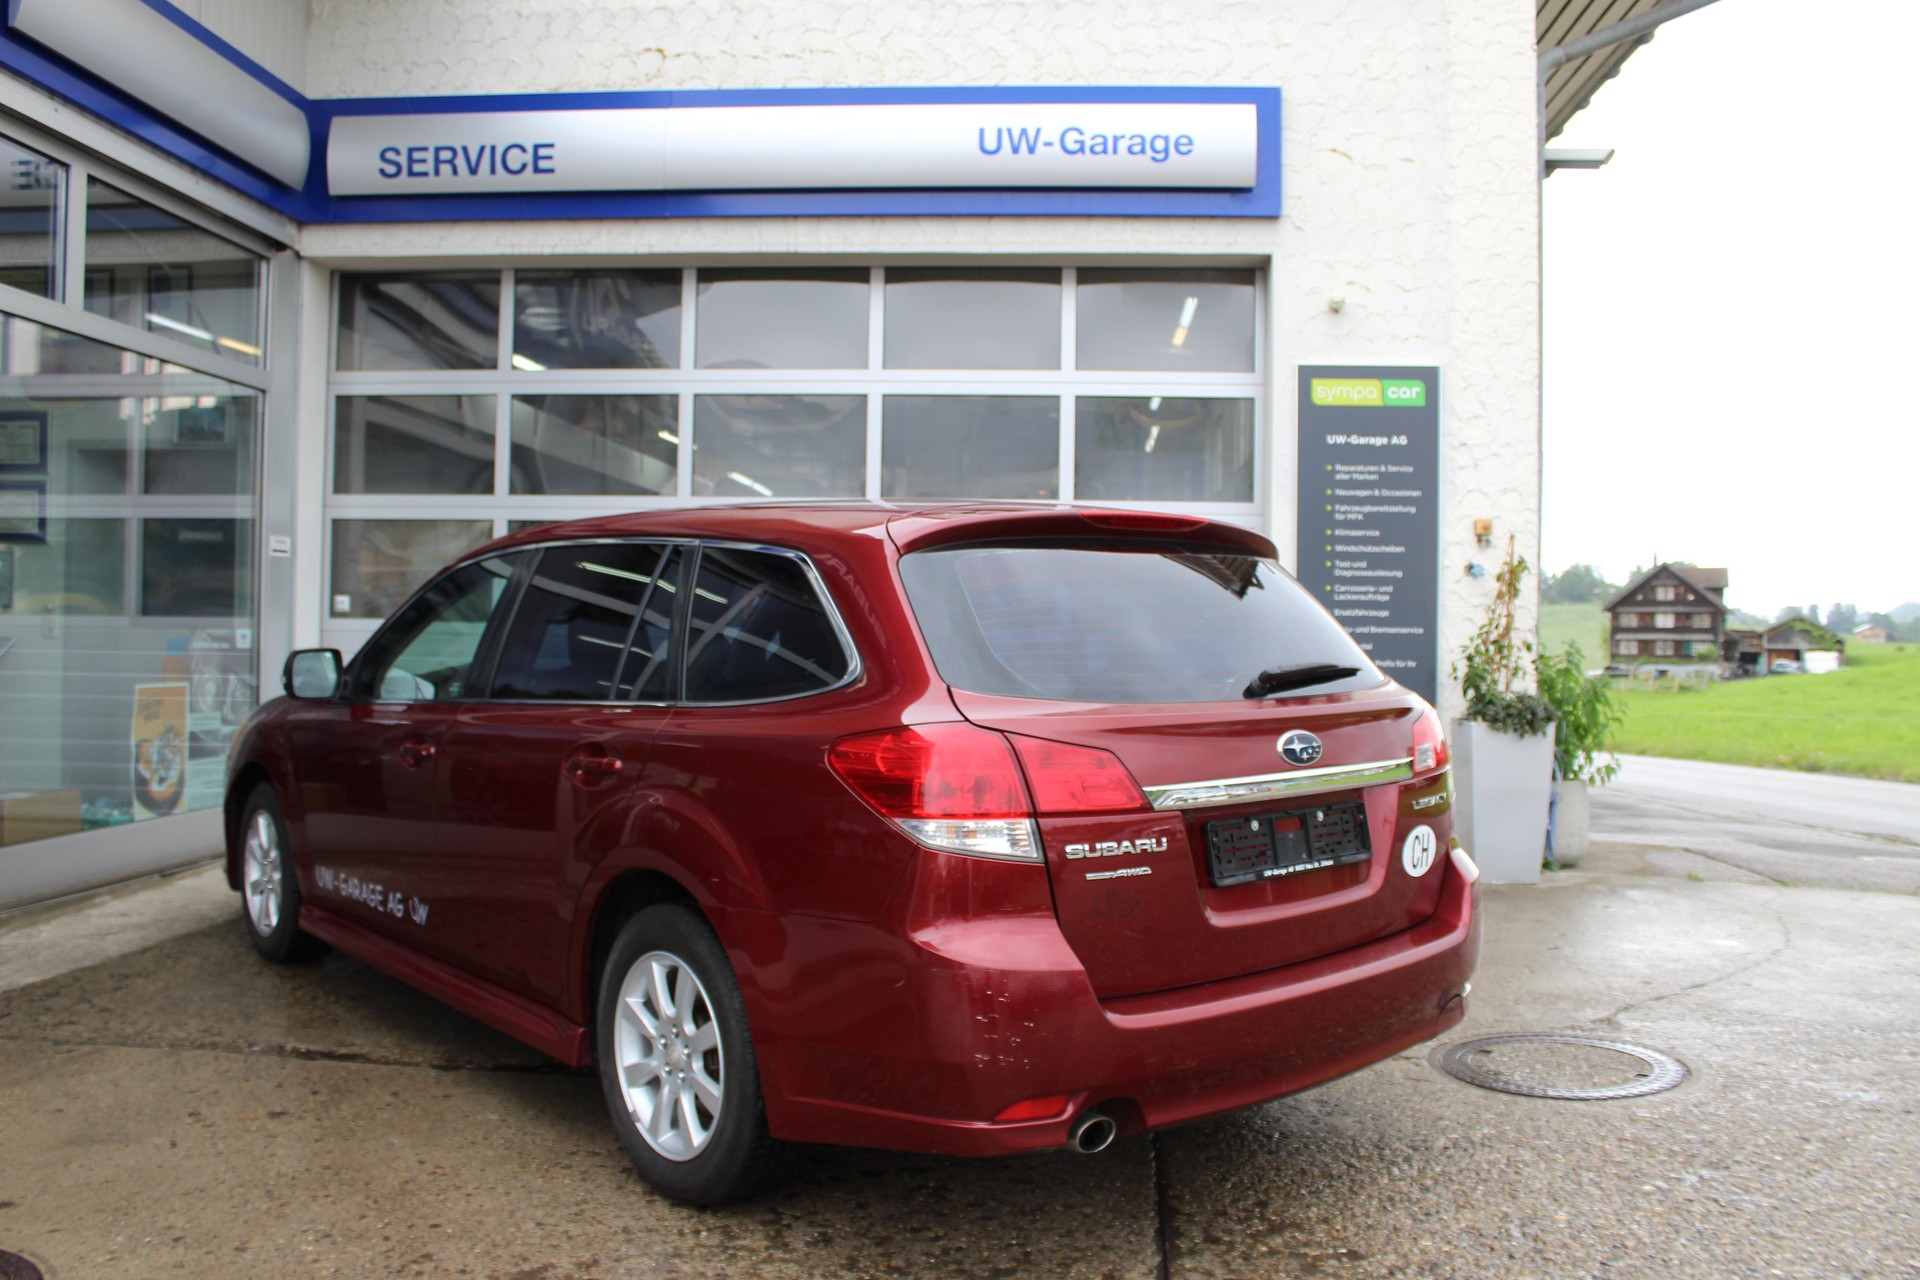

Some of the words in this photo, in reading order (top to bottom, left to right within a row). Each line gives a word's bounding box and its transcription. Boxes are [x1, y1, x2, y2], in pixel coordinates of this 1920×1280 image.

[378, 143, 555, 179] SERVICE
[978, 126, 1194, 163] UW-Garage
[1316, 385, 1378, 401] sympa
[1387, 386, 1420, 399] car
[1326, 434, 1388, 446] UW-Garage
[1390, 435, 1408, 445] AG
[1334, 464, 1379, 473] Reparaturen
[1380, 464, 1386, 472] &
[1387, 465, 1414, 473] Service
[1334, 488, 1374, 497] Neuwagen
[1374, 488, 1380, 496] &
[1381, 488, 1422, 497] Occasionen
[1334, 529, 1380, 537] Klimaservice
[1334, 545, 1406, 553] Windschutzscheiben
[1334, 568, 1403, 578] Diagnoseauslesung
[1379, 585, 1393, 593] und
[1334, 608, 1390, 618] Ersatzfahrzeuge
[1370, 625, 1424, 634] Bremsenservice
[1065, 837, 1168, 859] SUBARU
[1412, 832, 1431, 870] CH
[387, 891, 405, 918] AG
